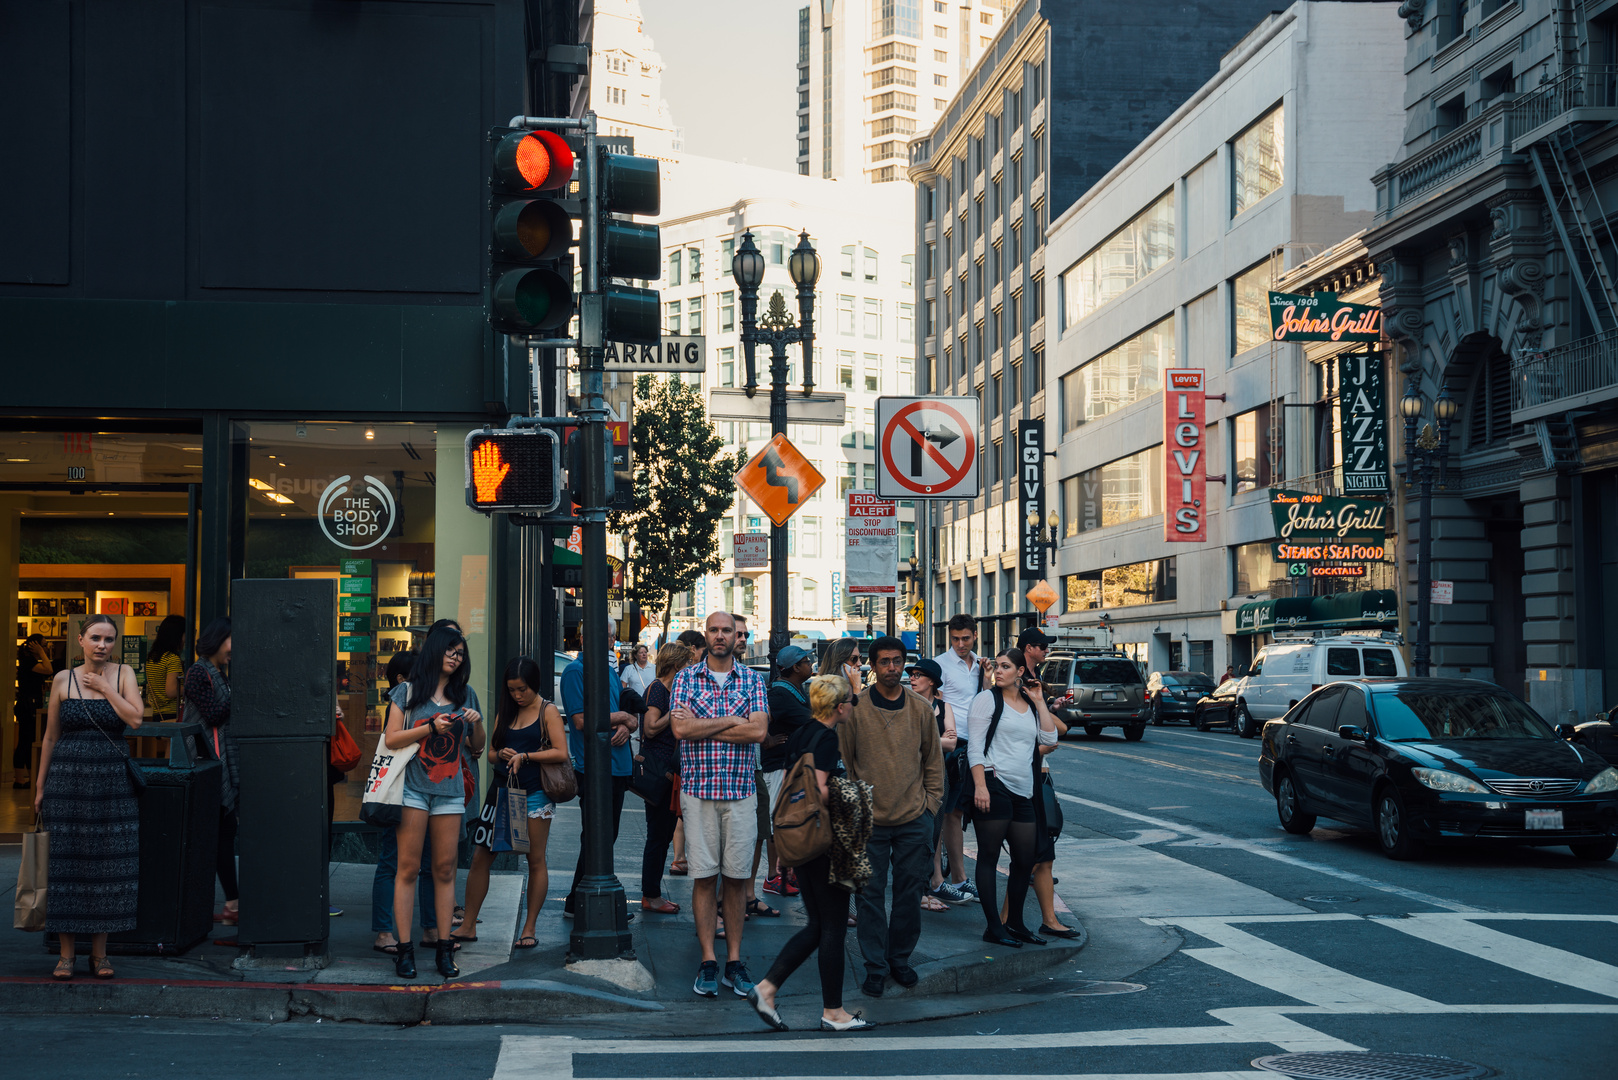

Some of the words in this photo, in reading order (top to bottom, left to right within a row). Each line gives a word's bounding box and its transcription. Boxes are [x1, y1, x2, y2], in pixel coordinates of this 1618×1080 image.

[1270, 296, 1294, 306] Since
[1297, 298, 1319, 307] 1908
[1274, 305, 1330, 340] John's
[1331, 306, 1379, 341] Grill
[604, 342, 699, 364] ARKING
[1350, 356, 1377, 471] JAZZ
[68, 467, 85, 480] 100
[1346, 475, 1387, 488] NIGHTLY
[343, 498, 370, 509] THE
[1272, 493, 1299, 503] Since
[334, 510, 381, 522] BODY
[854, 507, 891, 516] ALERT
[864, 519, 881, 527] STOP
[1281, 503, 1335, 538] John's
[1337, 503, 1385, 538] Grill
[336, 524, 379, 536] SHOP
[848, 528, 896, 536] DISCONTINUED
[735, 535, 745, 543] NO
[1277, 544, 1322, 560] STEAKS
[1289, 563, 1306, 575] 63
[1311, 567, 1363, 575] COCKTAILS
[832, 573, 840, 615] ROSS
